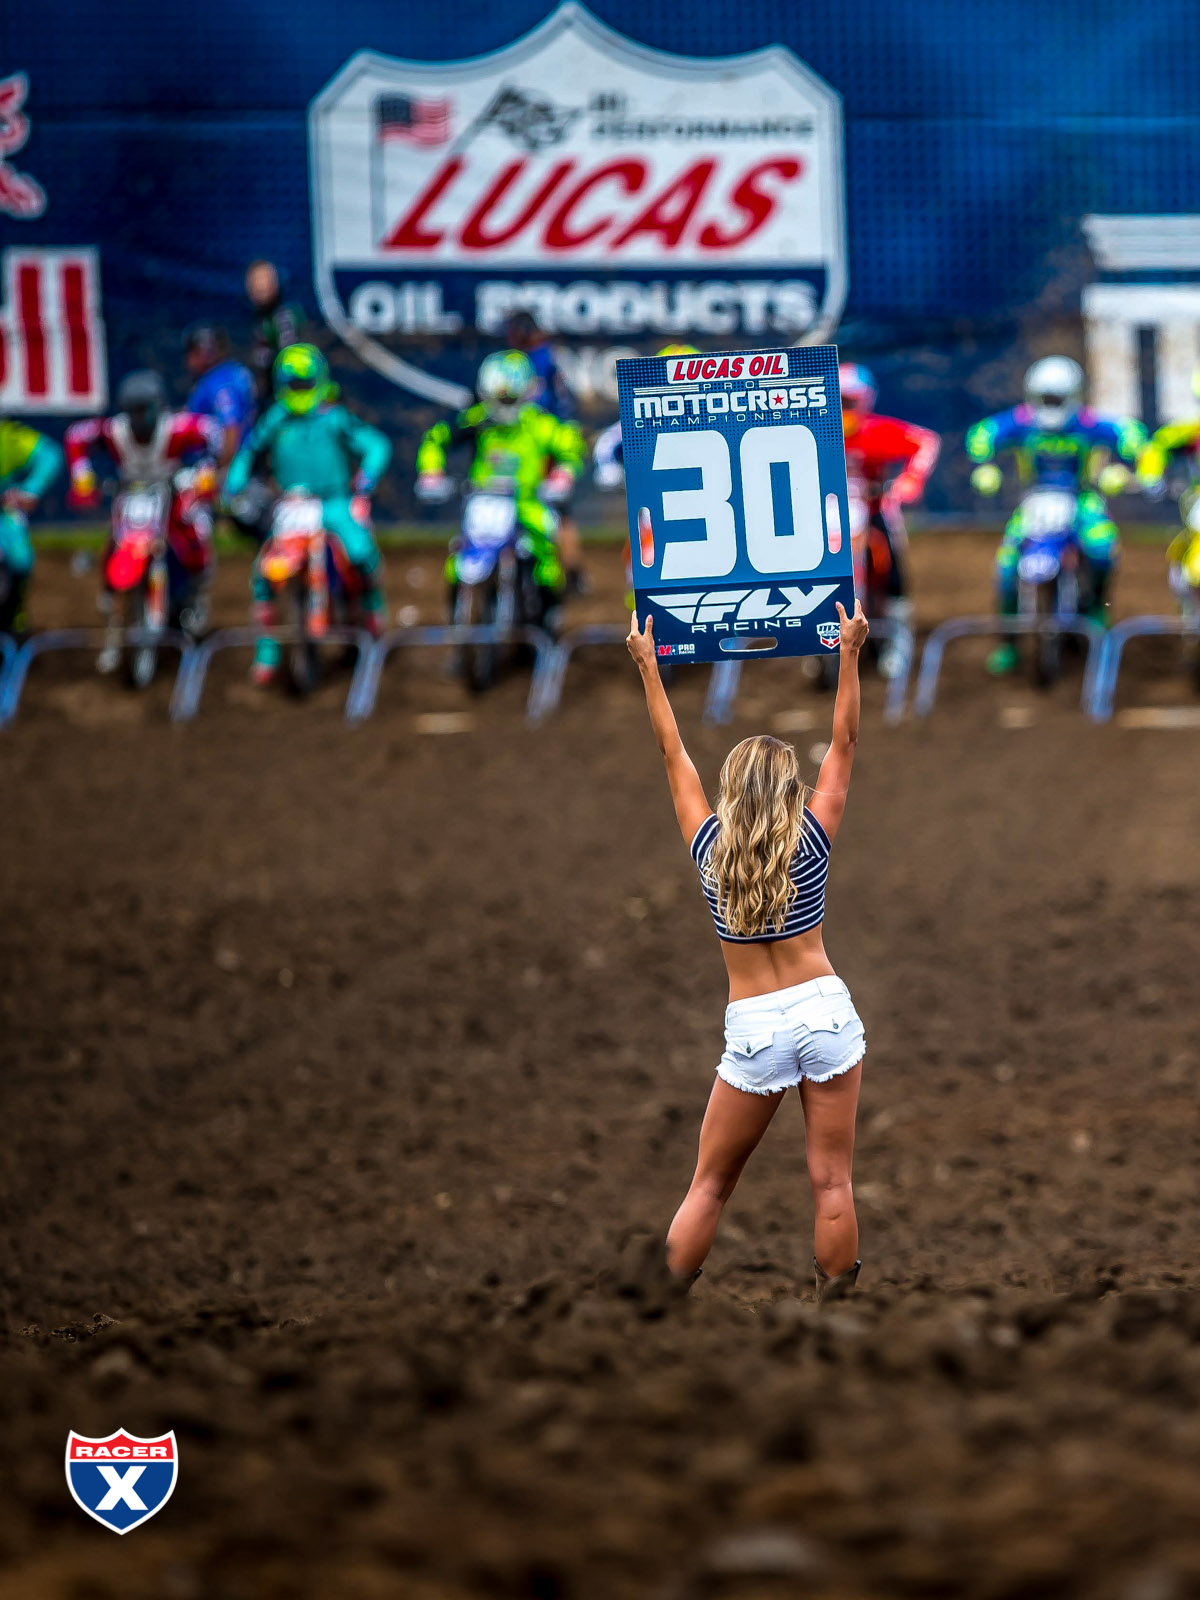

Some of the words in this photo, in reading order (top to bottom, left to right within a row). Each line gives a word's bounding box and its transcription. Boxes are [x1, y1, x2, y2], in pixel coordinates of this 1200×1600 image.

[381, 153, 807, 253] LUCAS
[347, 281, 462, 335] OIL
[477, 281, 818, 335] PRODUCTS
[673, 357, 744, 381] LUCAS
[748, 355, 784, 376] OIL
[703, 380, 755, 391] PRO
[633, 386, 827, 419] MOTOCROSS
[635, 408, 828, 428] CHAMPIONSHIP
[652, 424, 825, 581] 30
[647, 584, 840, 623] FLY
[691, 618, 802, 633] RACING
[678, 643, 695, 651] PRO
